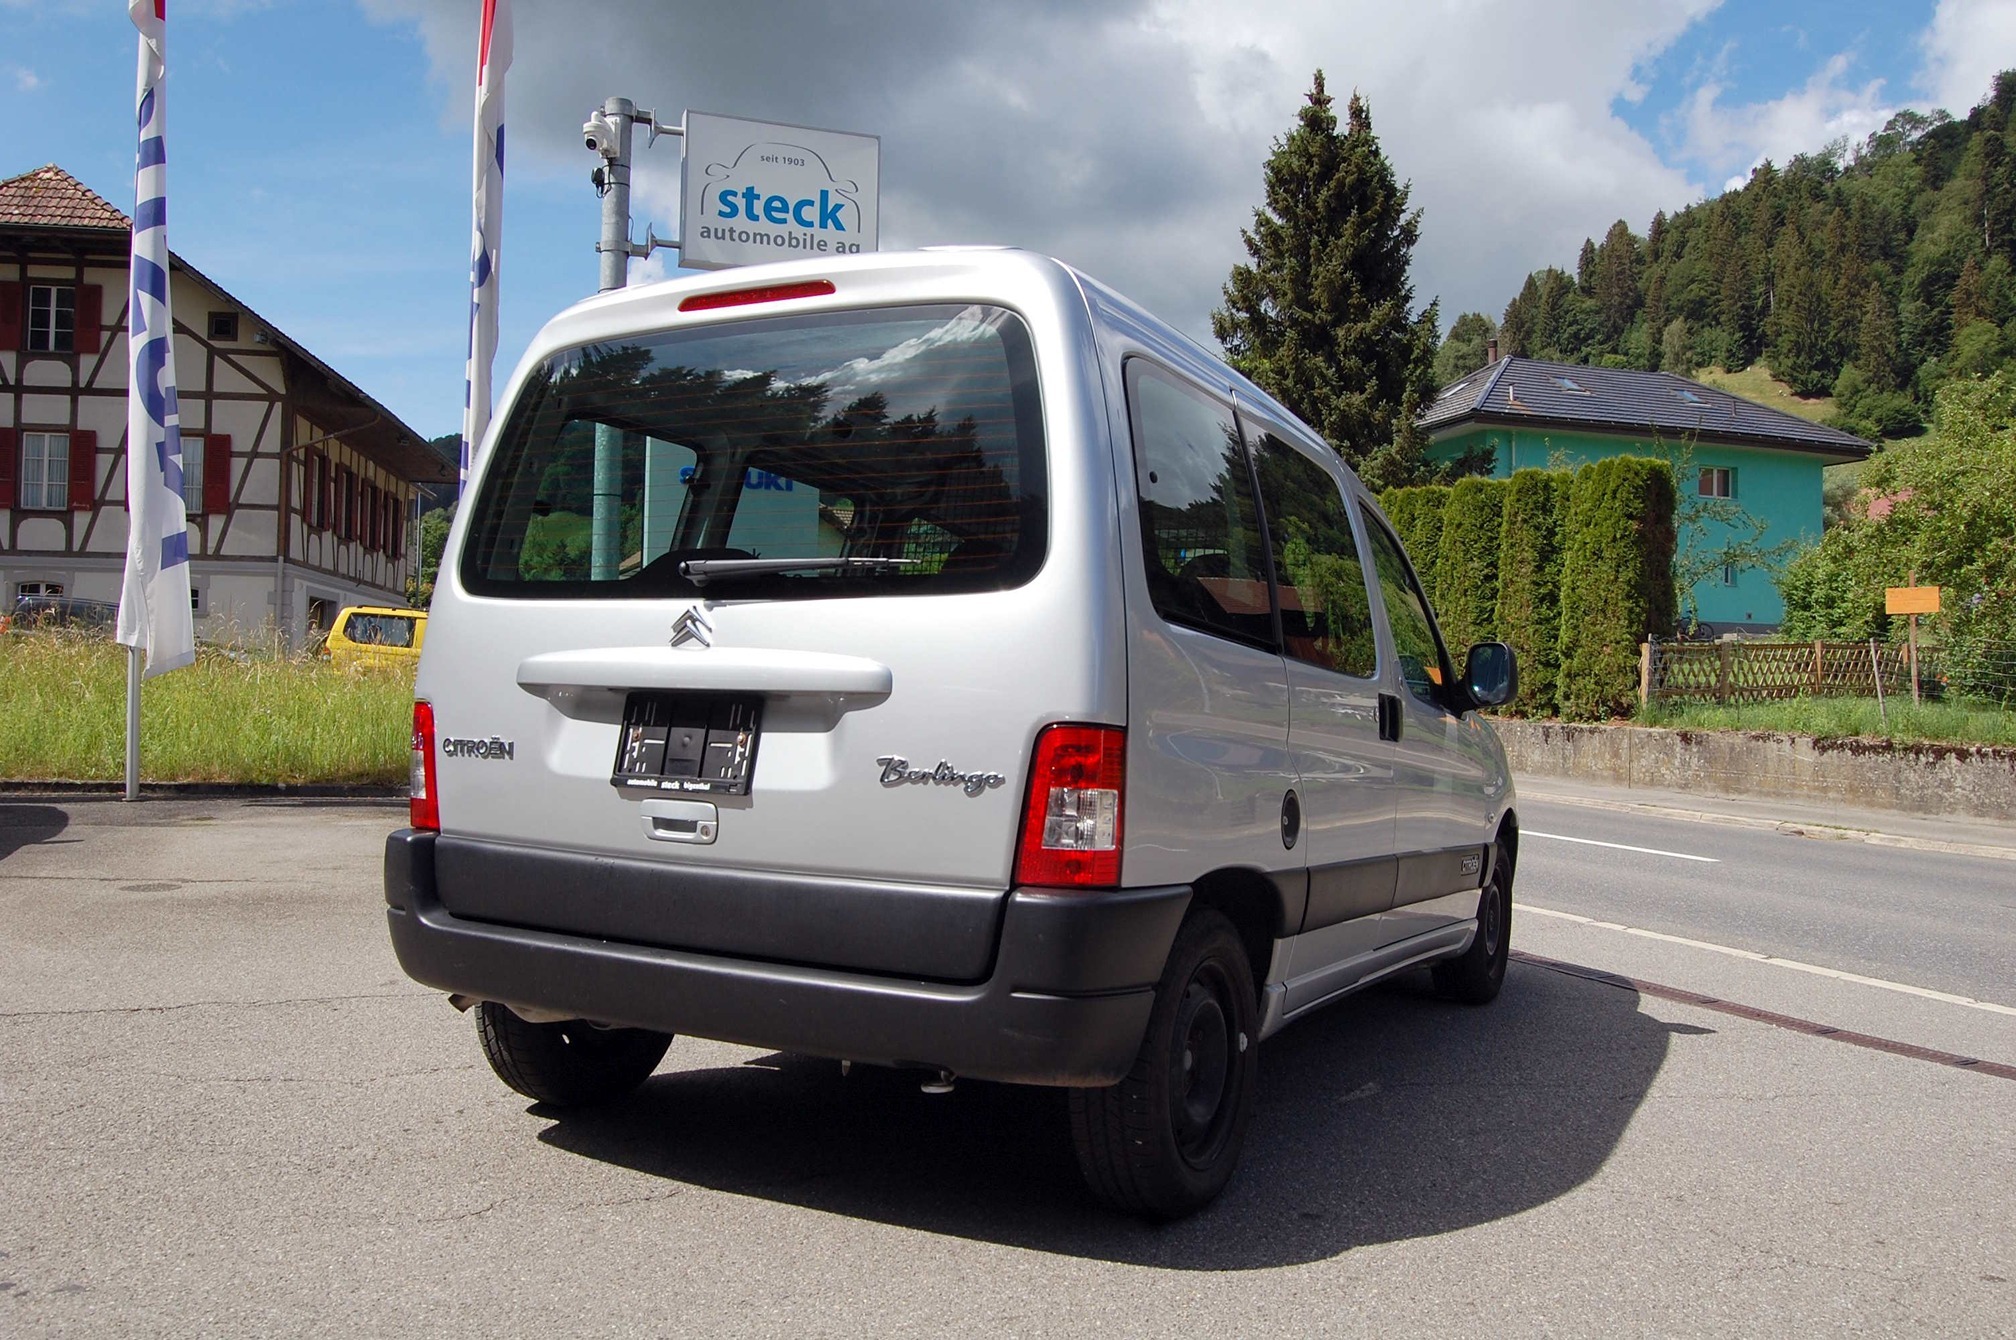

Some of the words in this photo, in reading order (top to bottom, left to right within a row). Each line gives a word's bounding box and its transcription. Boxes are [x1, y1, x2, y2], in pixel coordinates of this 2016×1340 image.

[760, 154, 779, 165] seit
[782, 156, 805, 167] 1903
[717, 185, 846, 232] steck
[700, 224, 828, 253] automobile
[443, 736, 515, 760] CITROËN
[660, 780, 680, 790] steck
[876, 754, 1006, 798] Berlingo
